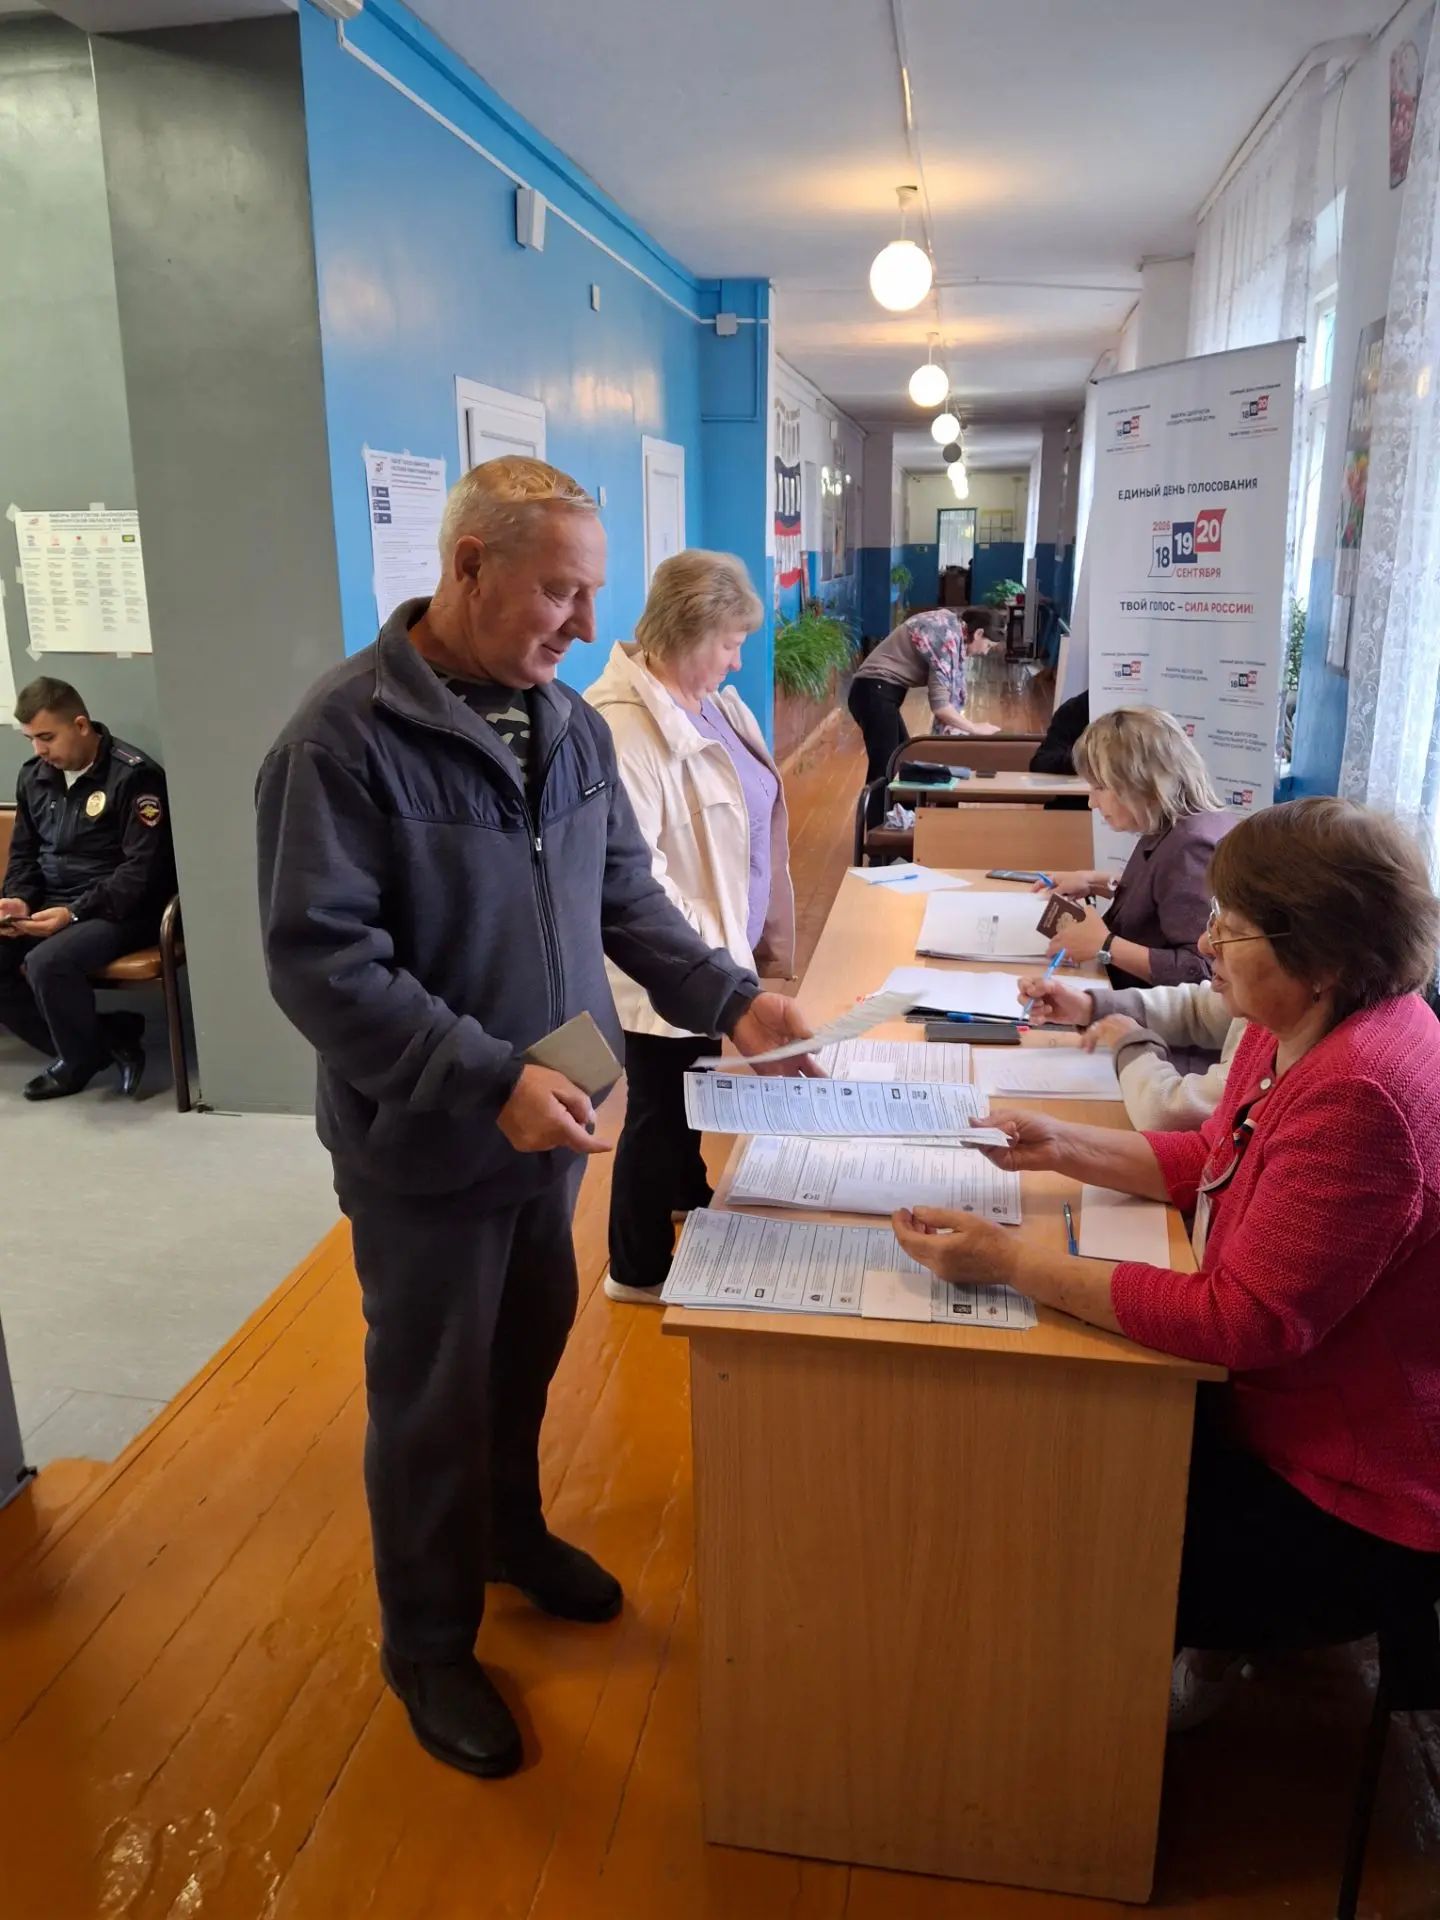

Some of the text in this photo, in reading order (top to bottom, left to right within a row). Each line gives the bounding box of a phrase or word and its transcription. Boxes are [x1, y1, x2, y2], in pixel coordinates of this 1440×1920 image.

[1118, 478, 1258, 501] ЕДИНЫЙ ДЕНЬ ГОЛОСОВАНИЯ
[1155, 519, 1220, 568] 18 19 20
[1176, 568, 1221, 578] СЕНТЯБРЯ
[1120, 599, 1147, 611] ТВОЙ
[1149, 602, 1175, 612] ГОЛОС
[1184, 602, 1209, 613] СИЛА
[1211, 603, 1254, 614] РОССИИ!
